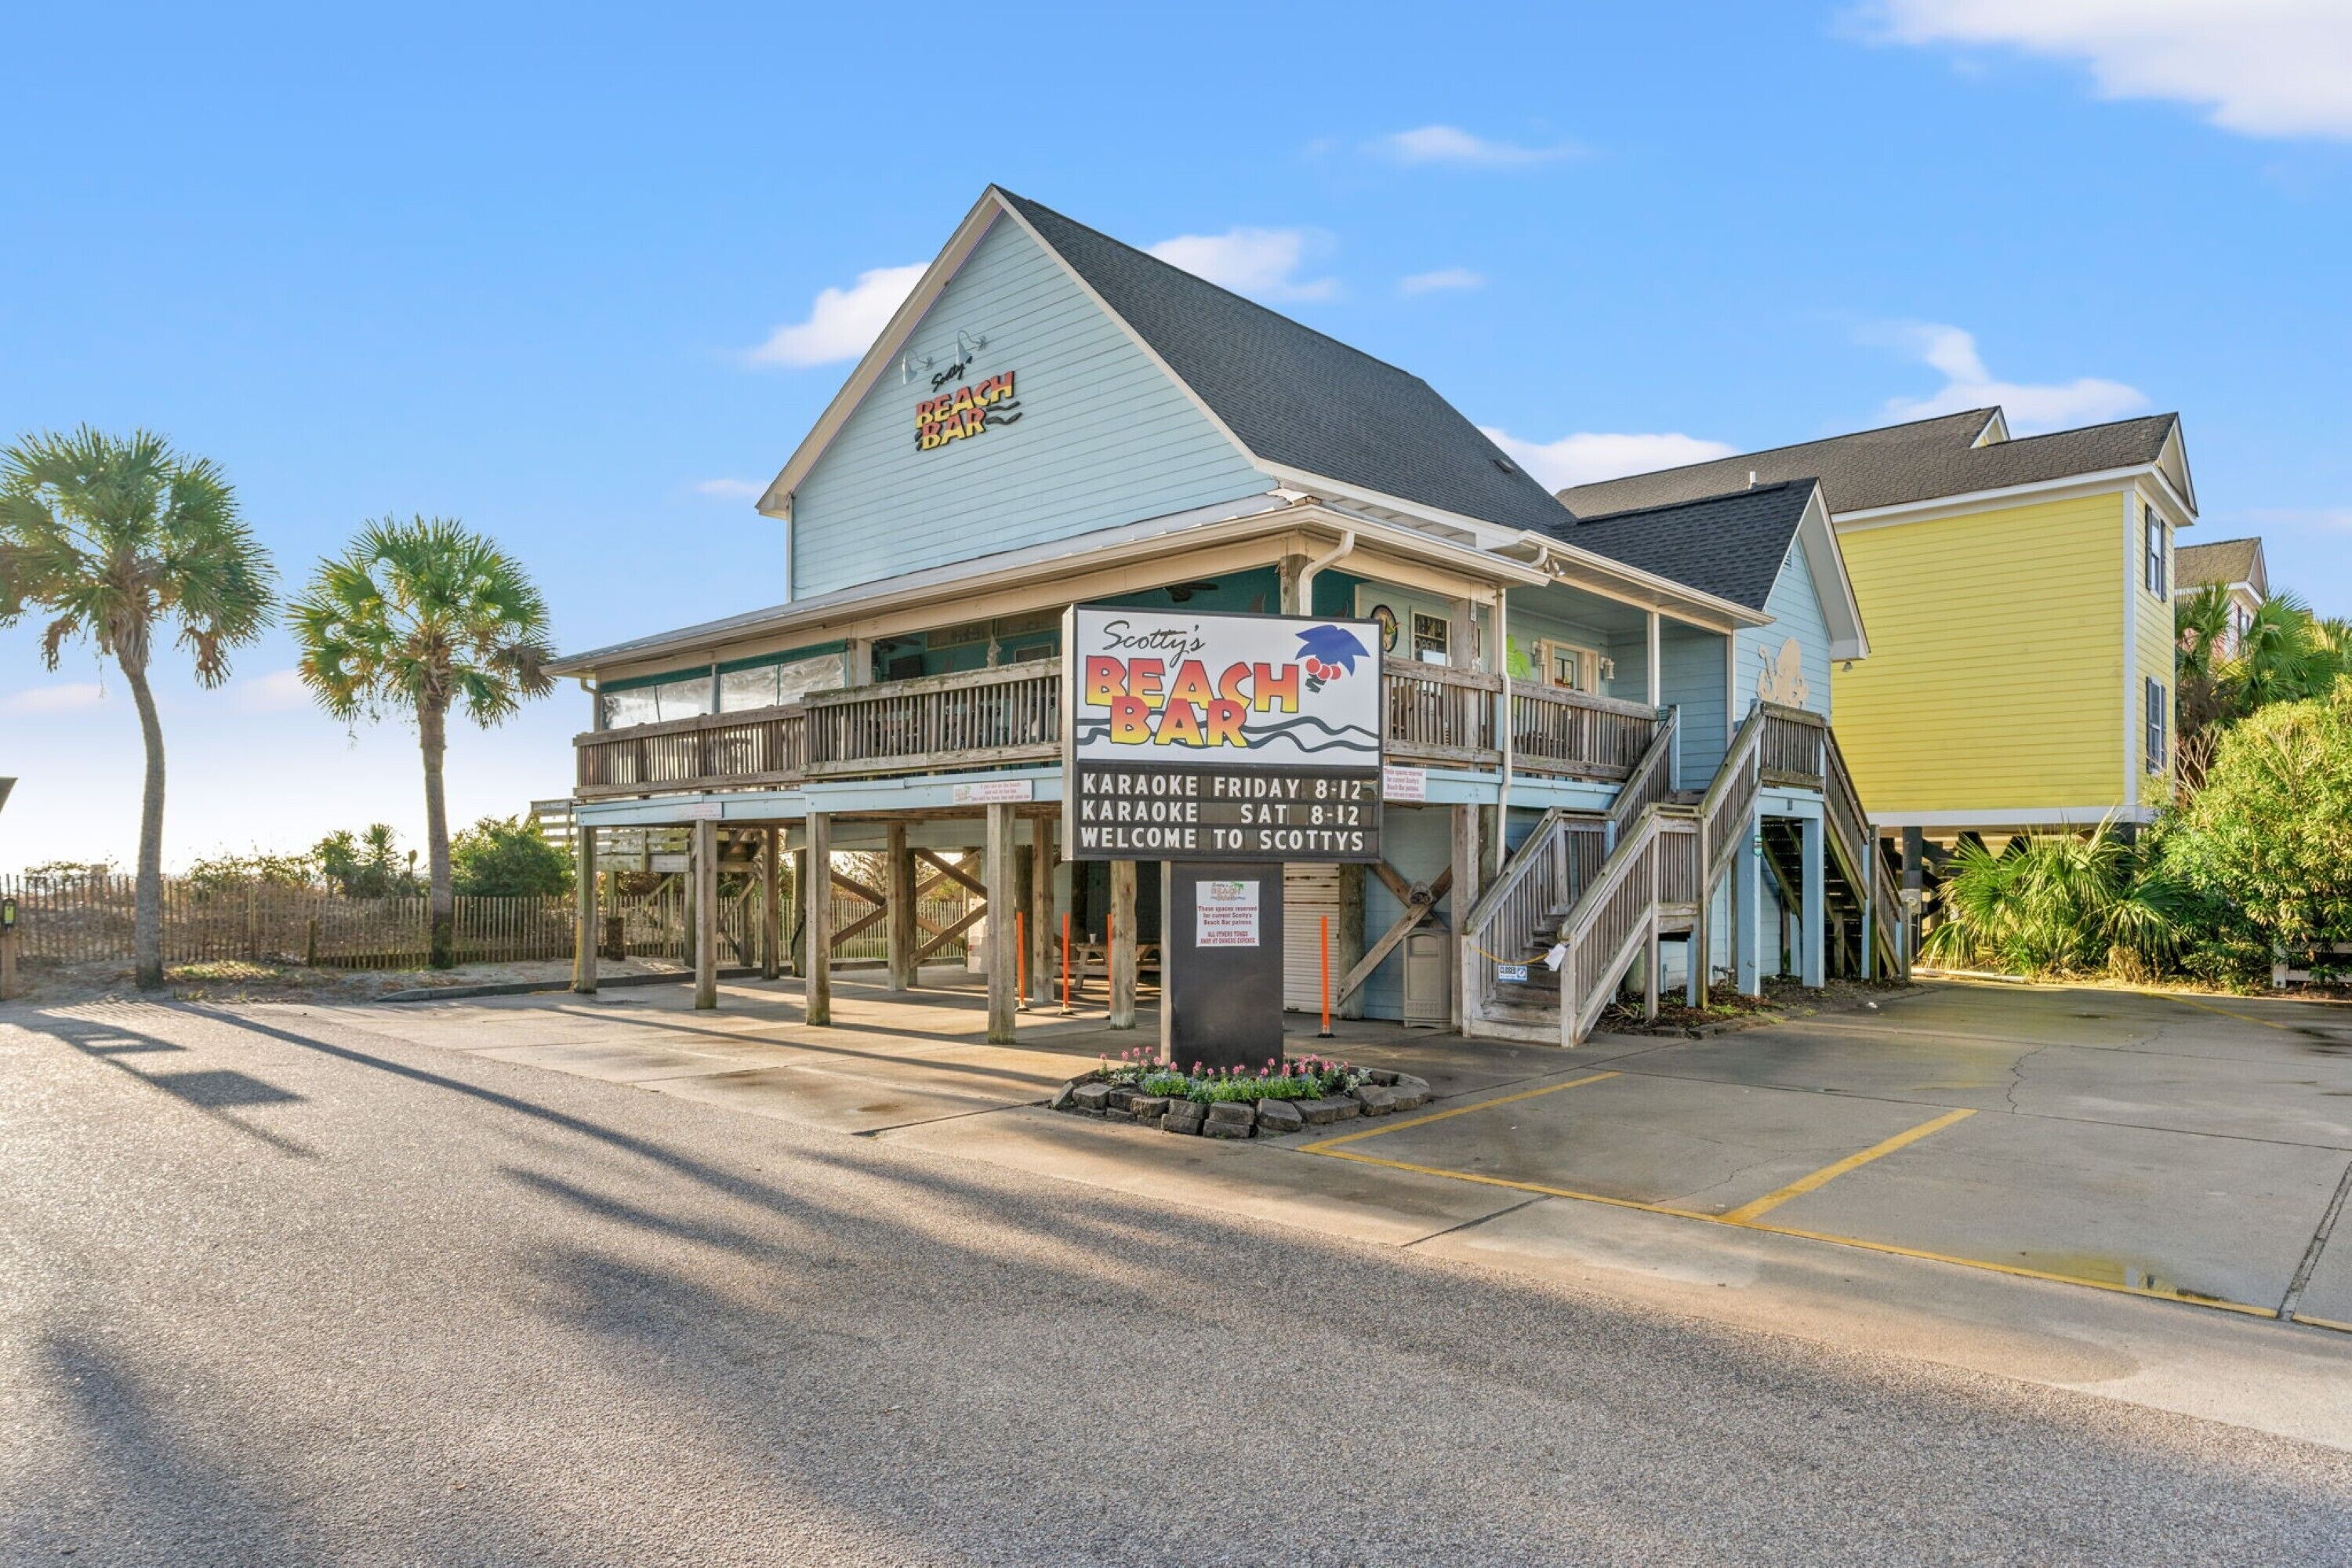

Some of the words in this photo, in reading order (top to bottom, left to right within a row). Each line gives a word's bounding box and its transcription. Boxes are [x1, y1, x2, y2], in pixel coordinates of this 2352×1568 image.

[916, 370, 1015, 428] BEACH
[920, 407, 986, 451] BAR
[1102, 620, 1206, 668] Scotty's
[1085, 655, 1299, 713] BEACH
[1110, 695, 1249, 748] BAR
[1083, 773, 1197, 796] KARAOKE
[1214, 776, 1301, 798] FRIDAY
[1315, 779, 1361, 800] 8-12
[1082, 800, 1197, 822] KARAOKE
[1240, 804, 1287, 824] SAT
[1311, 805, 1359, 826] 8-12
[1080, 826, 1196, 849] WELCOME
[1213, 829, 1243, 849] TO
[1259, 829, 1363, 851] SCOTTYS
